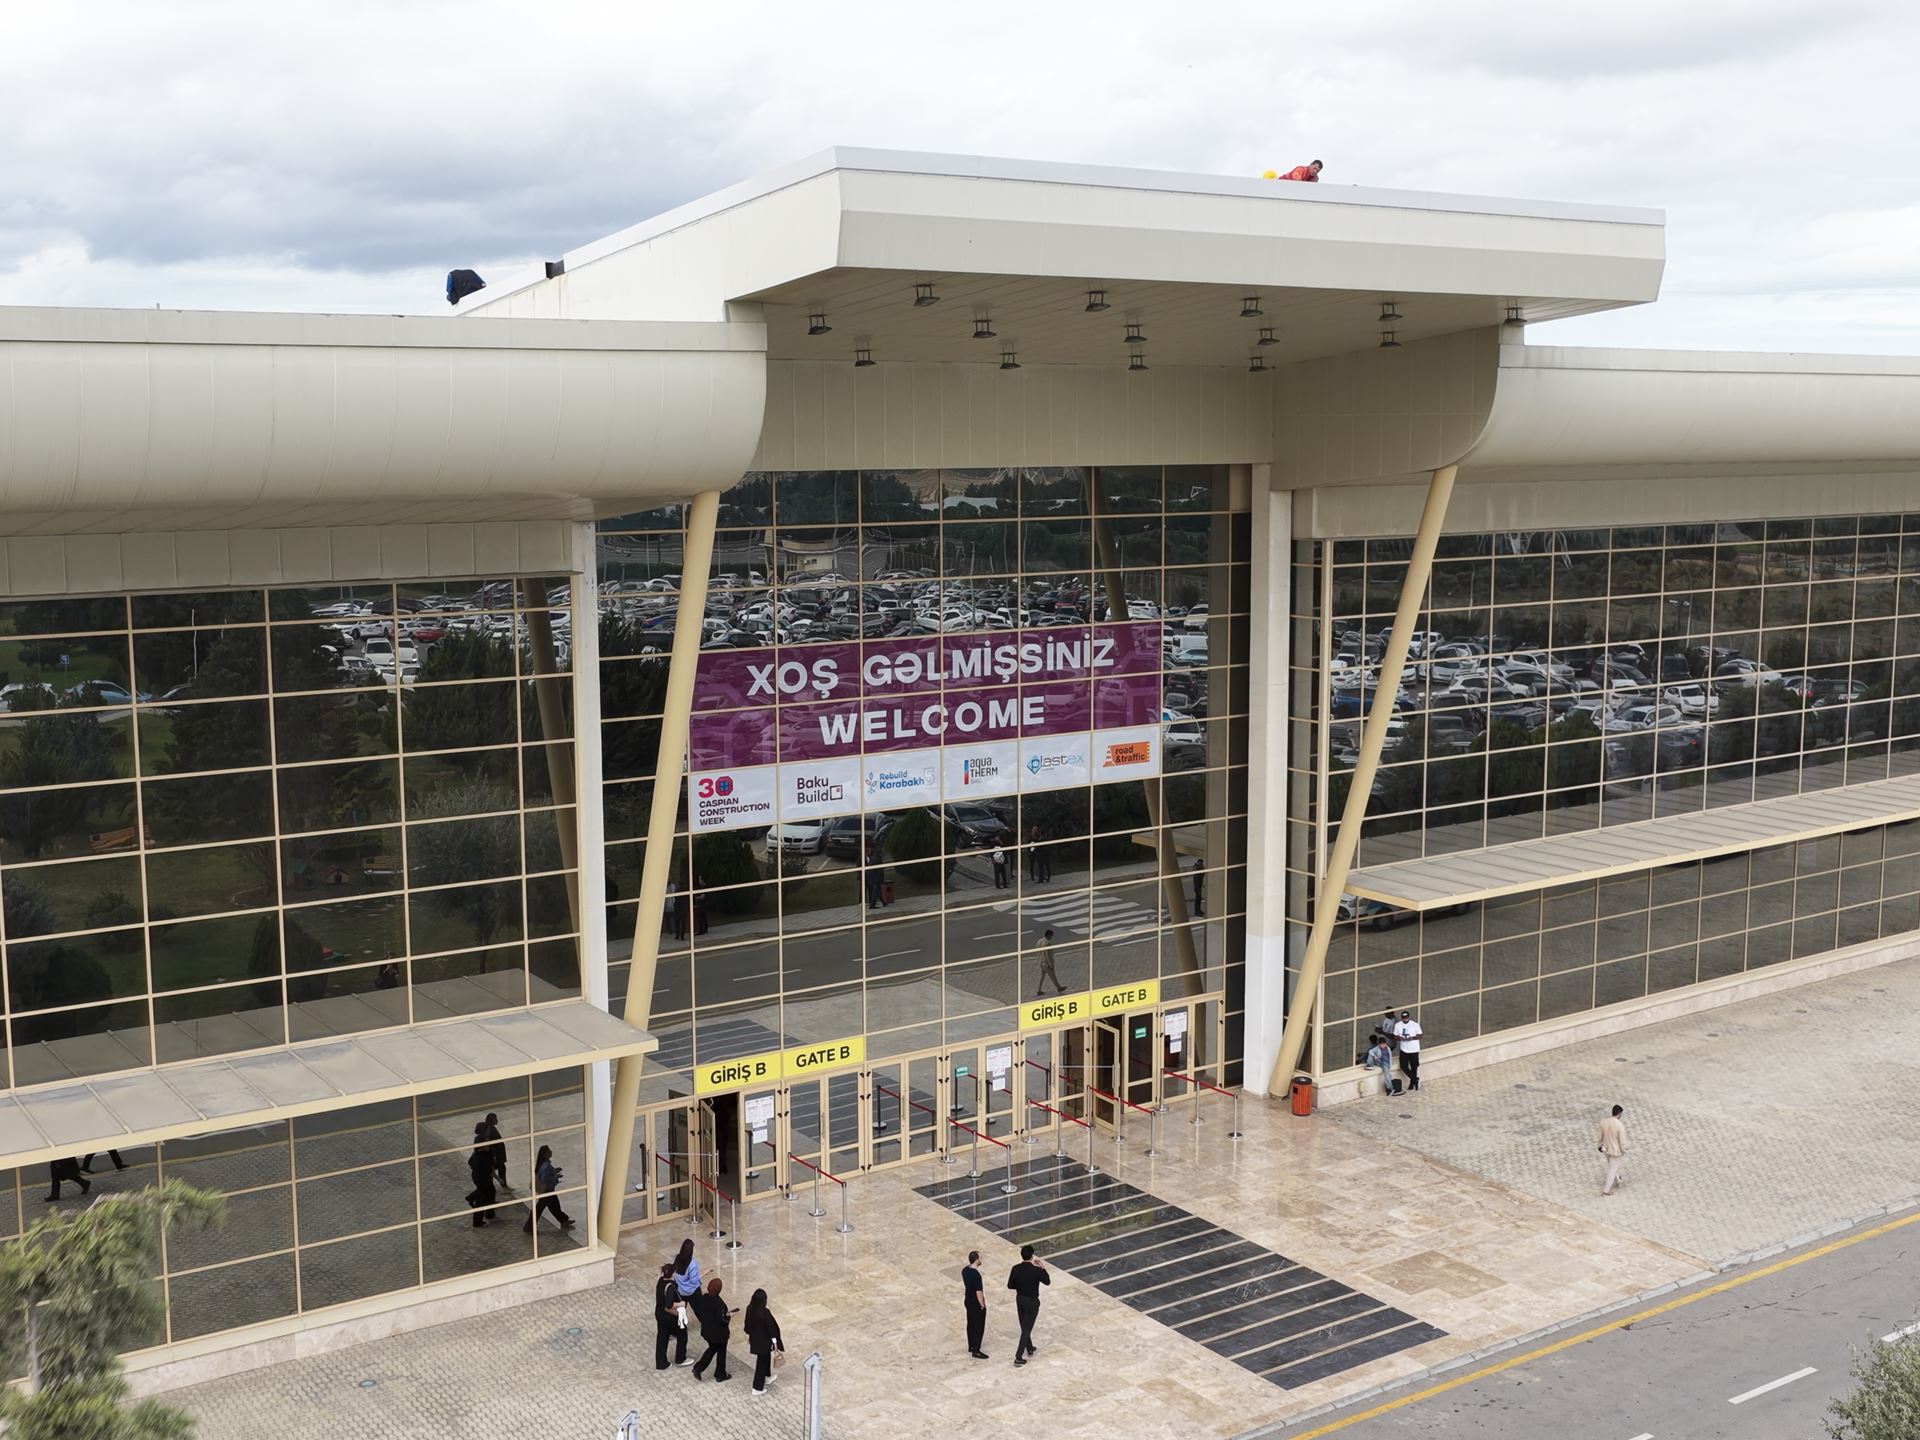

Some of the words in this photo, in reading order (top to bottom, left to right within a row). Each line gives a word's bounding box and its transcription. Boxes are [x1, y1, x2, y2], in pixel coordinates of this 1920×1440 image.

[746, 658, 839, 699] XOŞ
[863, 633, 1115, 686] GƏLMİŞSİNİZ
[818, 695, 1045, 746] WELCOME
[1115, 746, 1134, 754] road
[969, 757, 992, 769] aqua
[1115, 753, 1145, 764] &traffic
[880, 771, 908, 780] Rebuild
[970, 767, 999, 778] THERM
[698, 775, 734, 799] 30
[797, 776, 829, 790] Baku
[880, 777, 925, 790] Karabakh
[699, 797, 739, 809] CASPIAN
[797, 789, 829, 804] Build
[699, 803, 770, 817] CONSTRUCTION
[700, 816, 726, 826] WEEK
[1102, 990, 1135, 1008] GATE
[1138, 988, 1147, 1001] B
[1031, 1002, 1065, 1022] GİRİŞ
[1068, 1001, 1078, 1014] B
[796, 1048, 836, 1067] GATE
[840, 1045, 850, 1059] B
[710, 1062, 752, 1084] GİRİŞ
[756, 1062, 767, 1076] B
